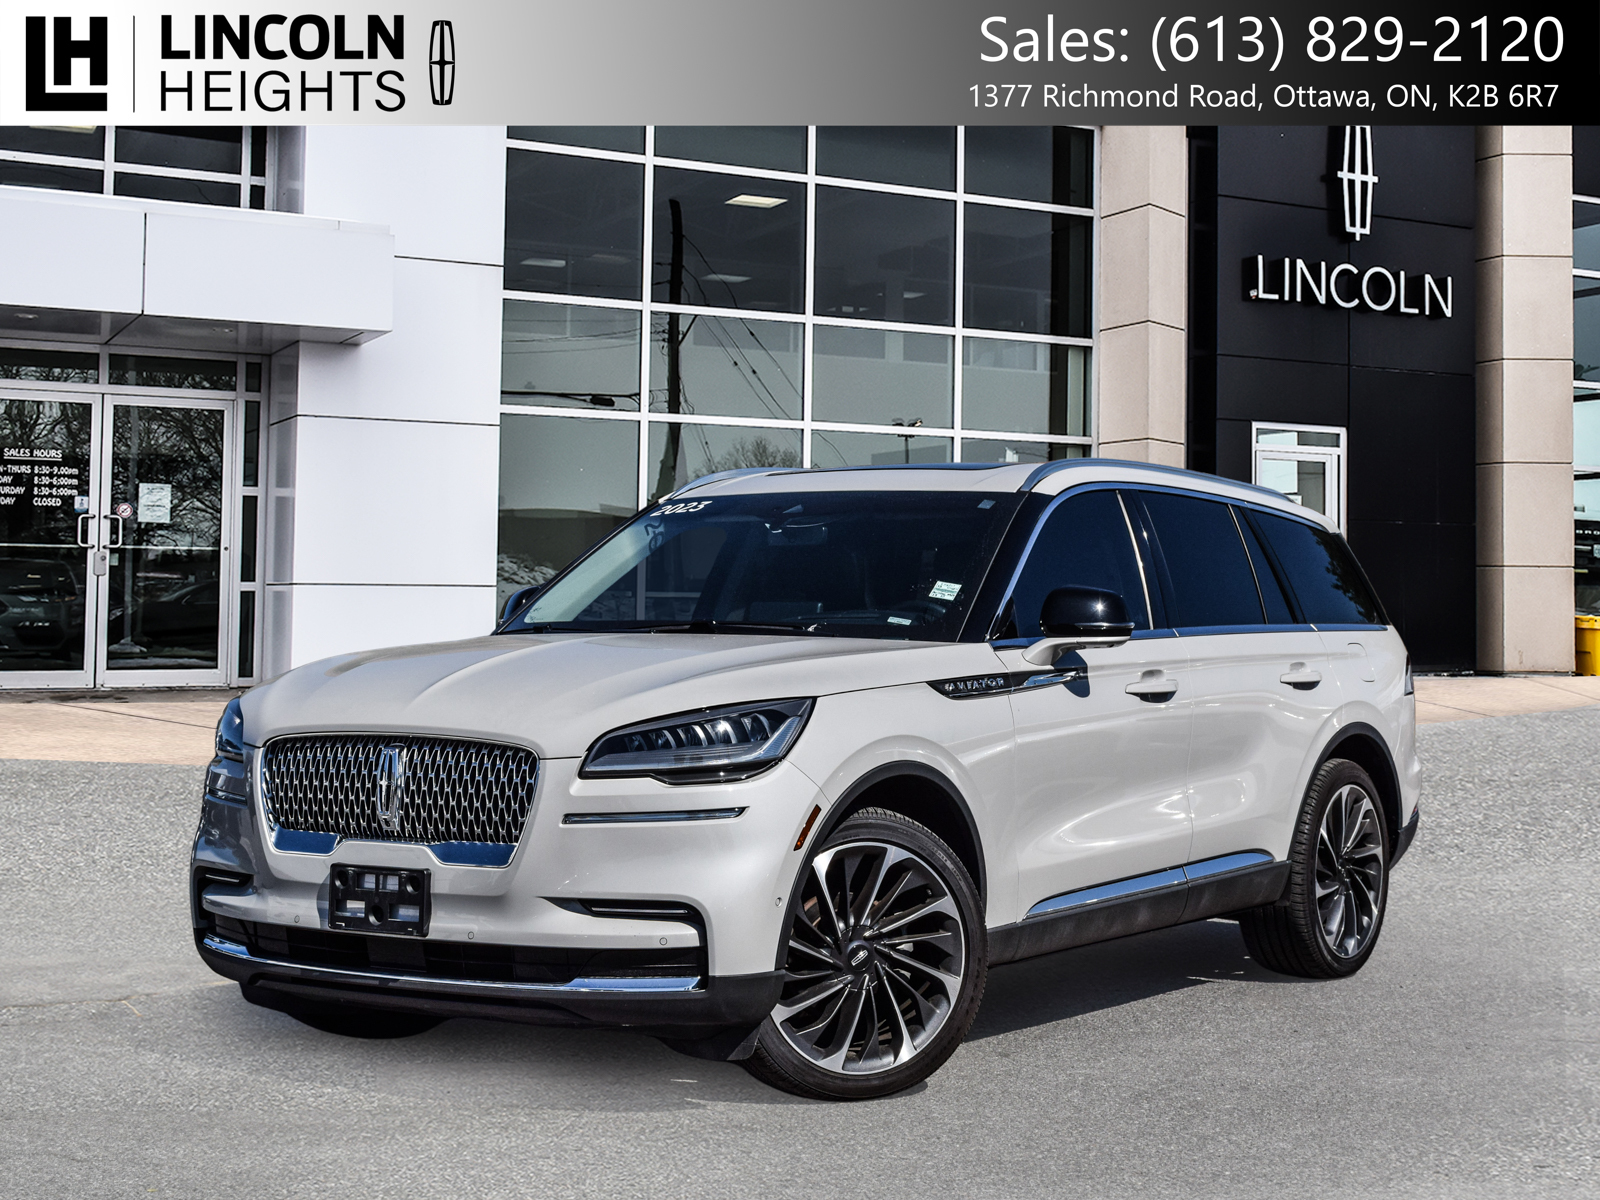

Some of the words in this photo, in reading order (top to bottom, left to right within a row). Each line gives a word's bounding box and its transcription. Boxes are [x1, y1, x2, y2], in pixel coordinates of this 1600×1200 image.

[1257, 254, 1452, 318] LINCOLN
[3, 447, 31, 457] SALES
[33, 449, 63, 458] HOURS
[32, 497, 62, 507] CLOSED
[649, 500, 713, 517] 2023
